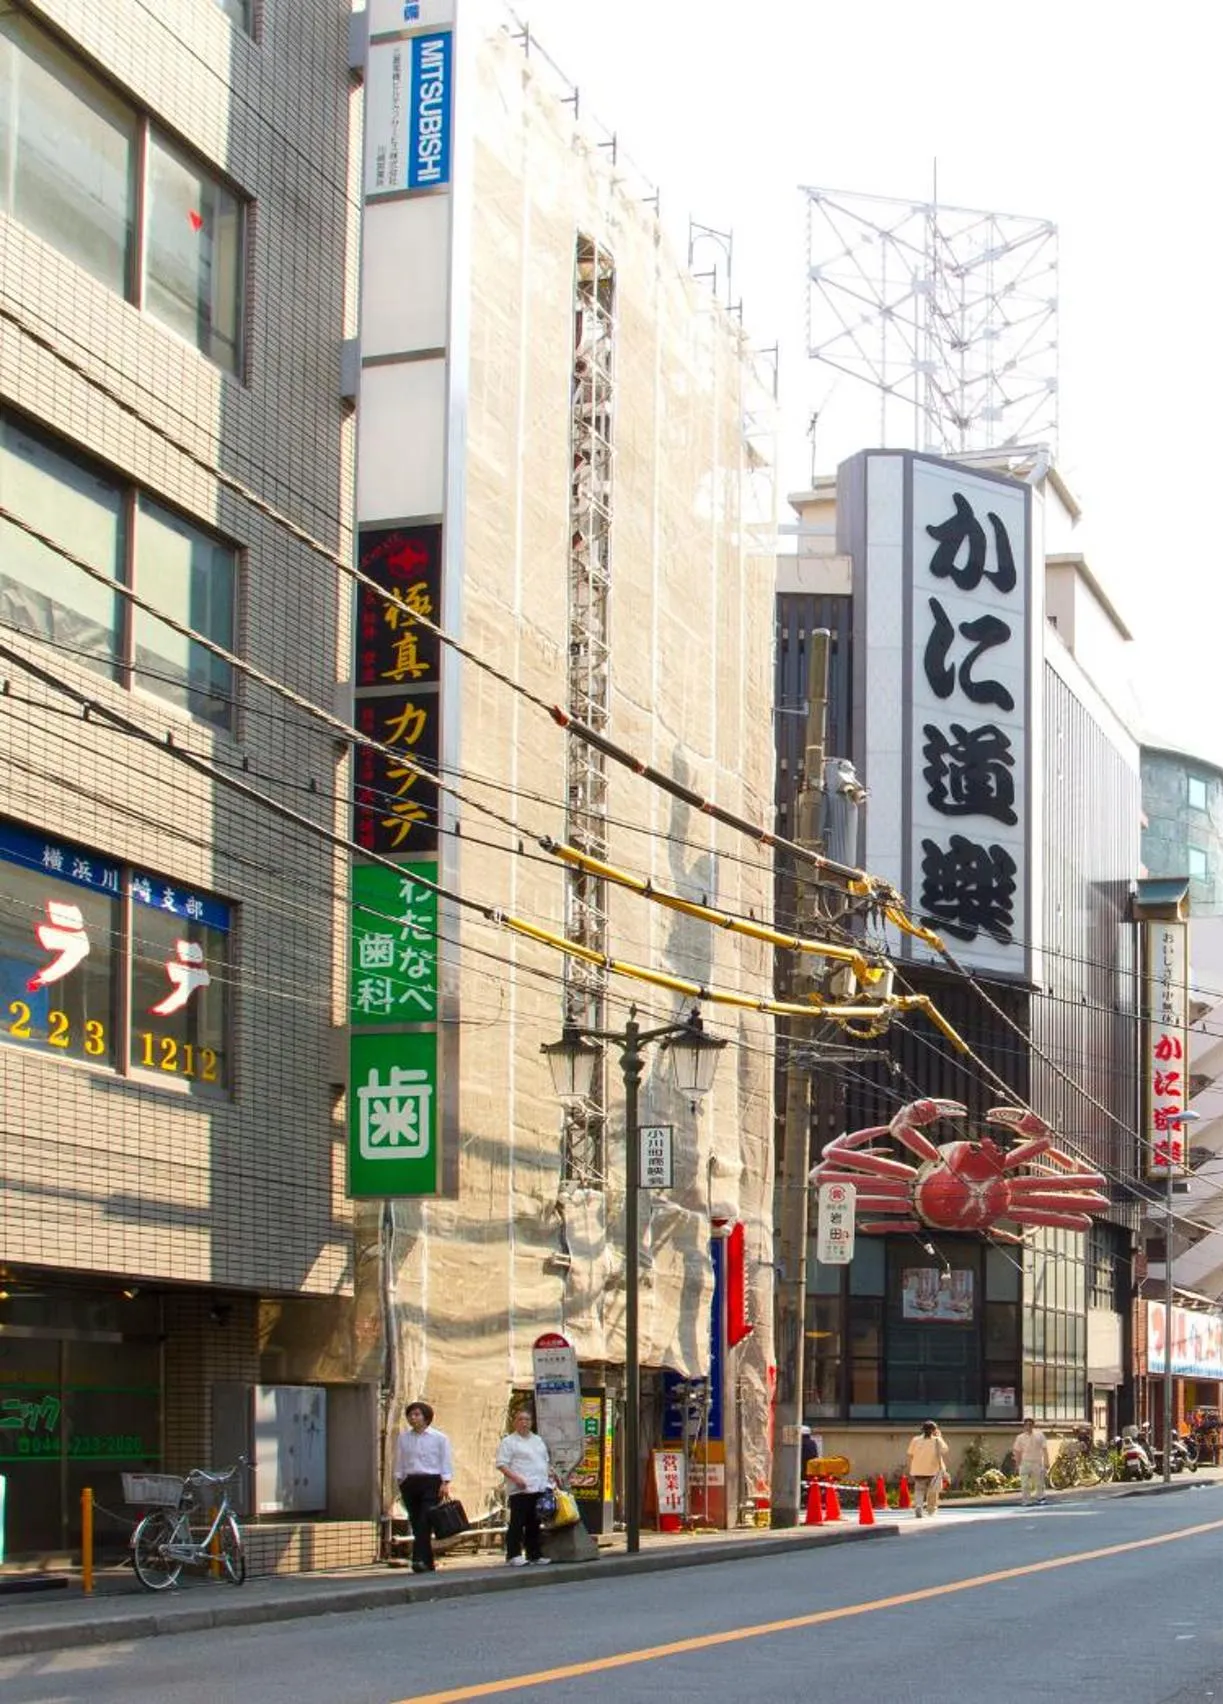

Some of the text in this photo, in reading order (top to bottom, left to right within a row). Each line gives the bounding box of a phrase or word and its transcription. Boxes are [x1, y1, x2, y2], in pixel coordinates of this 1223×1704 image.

[418, 40, 444, 181] MITSUBISHI
[380, 581, 433, 847] 極真 カラテ
[42, 845, 204, 919] 横浜川崎支部
[357, 933, 394, 1014] 歯科
[399, 877, 433, 1012] わたなべ
[9, 1002, 218, 1082] 223 1212
